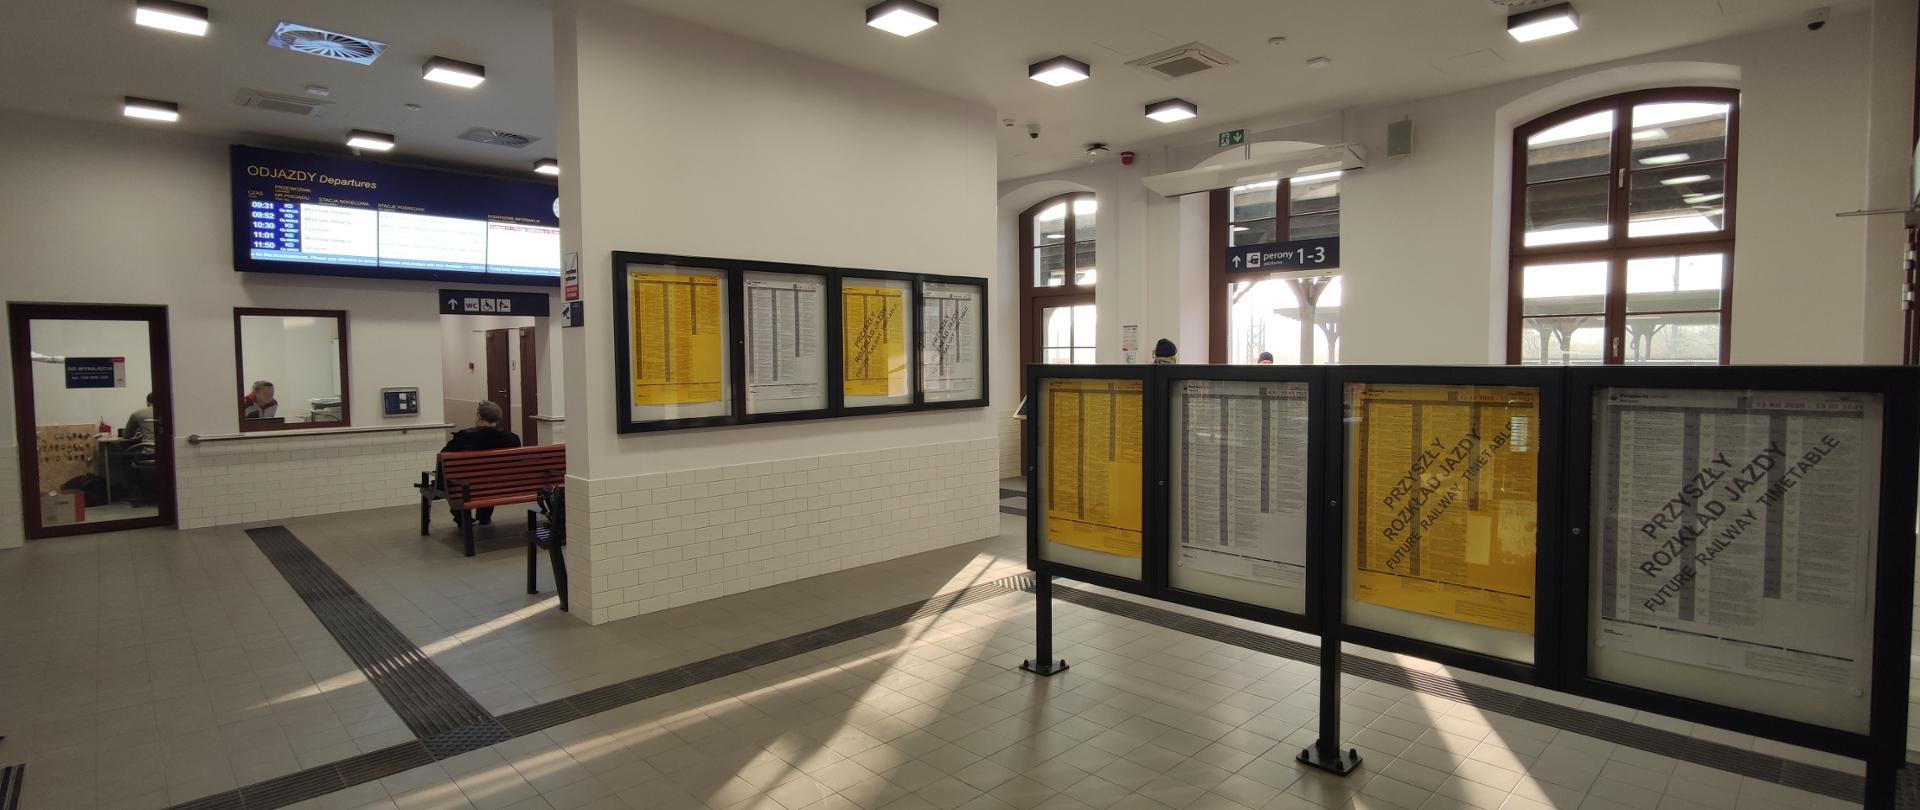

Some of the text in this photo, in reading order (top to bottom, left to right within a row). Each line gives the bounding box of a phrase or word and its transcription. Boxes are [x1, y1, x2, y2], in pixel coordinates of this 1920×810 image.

[248, 165, 377, 190] ODJAZDY Departures
[252, 201, 274, 209] 09:31
[252, 211, 275, 219] 09:52
[253, 221, 275, 229] 10:30
[253, 231, 275, 239] 11:01
[254, 241, 275, 249] 11:50
[1263, 246, 1326, 265] perony 1-3
[1383, 437, 1446, 510] PRZYSZŁY
[1383, 476, 1441, 541] ROZKŁAD
[1440, 427, 1481, 477] JAZDY
[1640, 452, 1733, 540] PRZYSZŁY
[1639, 500, 1726, 578] ROZKŁAD
[1724, 441, 1787, 502] JAZDY
[1386, 531, 1422, 570] FUTURE
[1420, 483, 1463, 530] RAILWAY
[1643, 565, 1697, 613] FUTURE
[1694, 508, 1758, 566] RAILWAY
[1756, 434, 1841, 507] TIMETABLE
